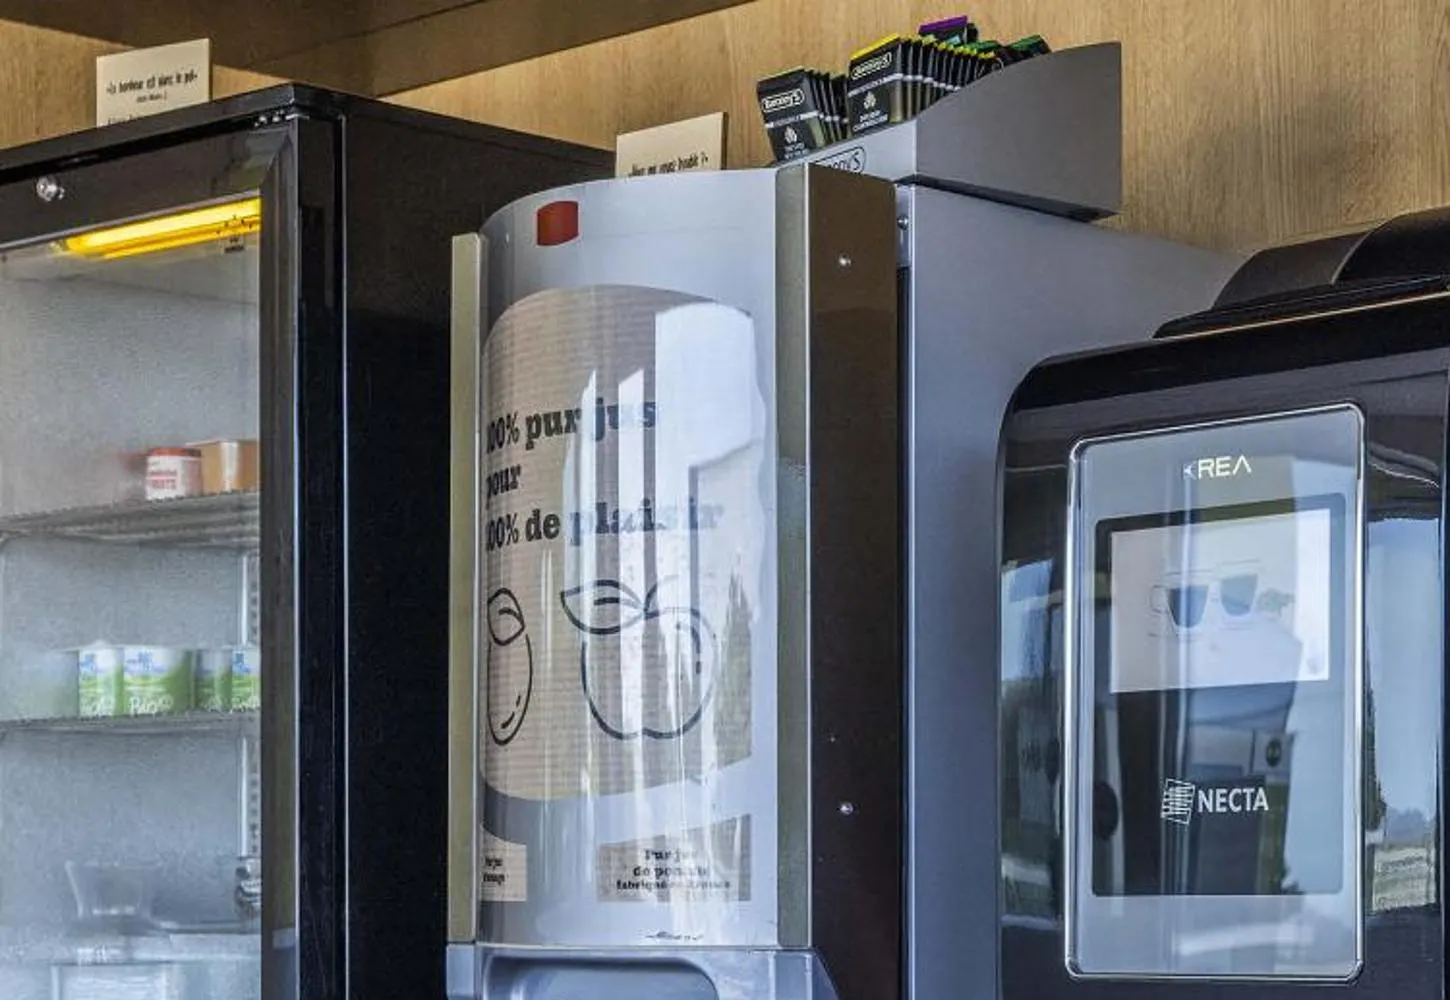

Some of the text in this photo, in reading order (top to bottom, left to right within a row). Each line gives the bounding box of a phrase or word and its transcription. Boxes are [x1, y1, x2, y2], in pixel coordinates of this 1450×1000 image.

[525, 407, 582, 451] pur
[526, 508, 561, 542] de
[1198, 787, 1269, 812] NECTA
